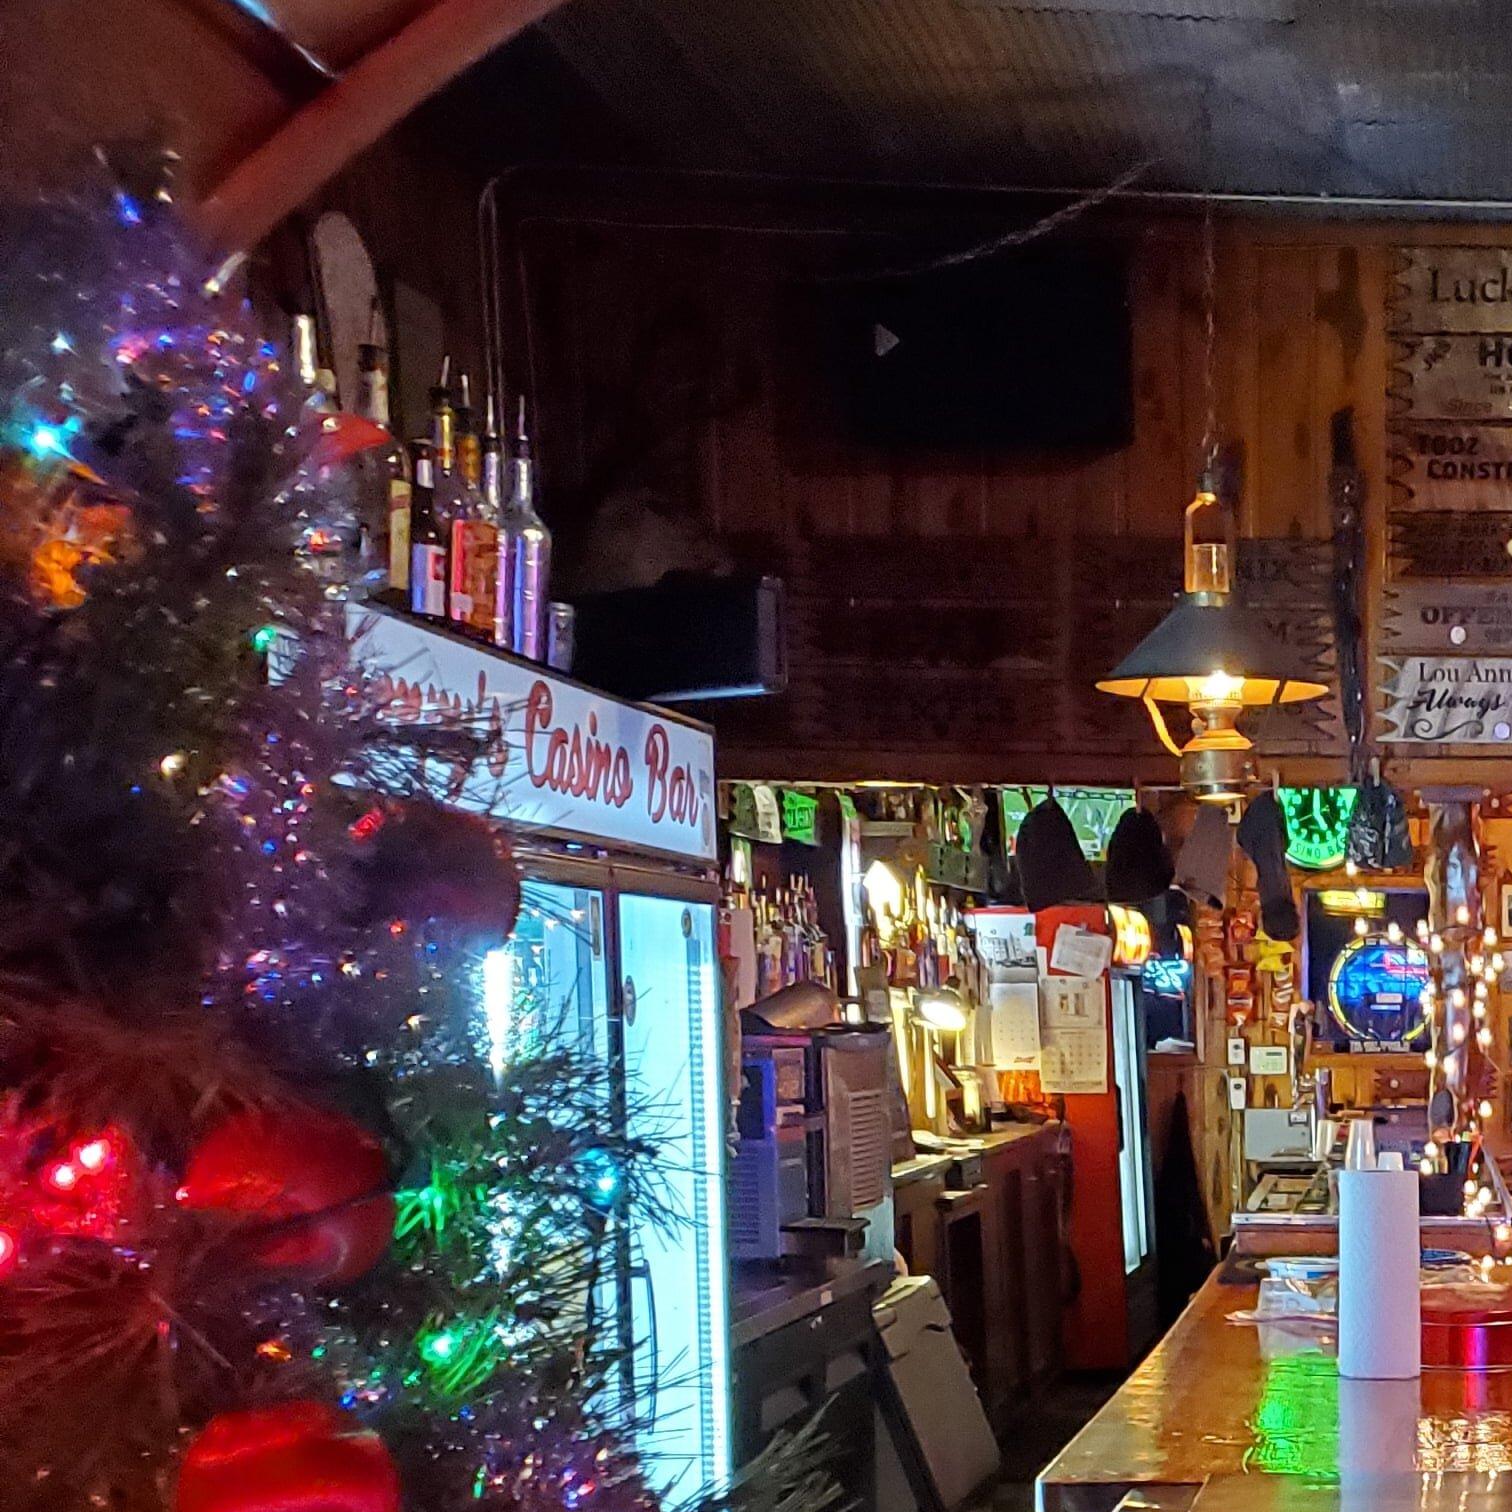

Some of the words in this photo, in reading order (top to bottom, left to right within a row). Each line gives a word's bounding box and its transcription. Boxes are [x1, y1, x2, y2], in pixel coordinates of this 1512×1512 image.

[1419, 661, 1460, 684] Lou
[1464, 664, 1512, 684] Ann
[1407, 689, 1505, 719] Always
[524, 680, 634, 808] Casino
[644, 723, 700, 828] Bar
